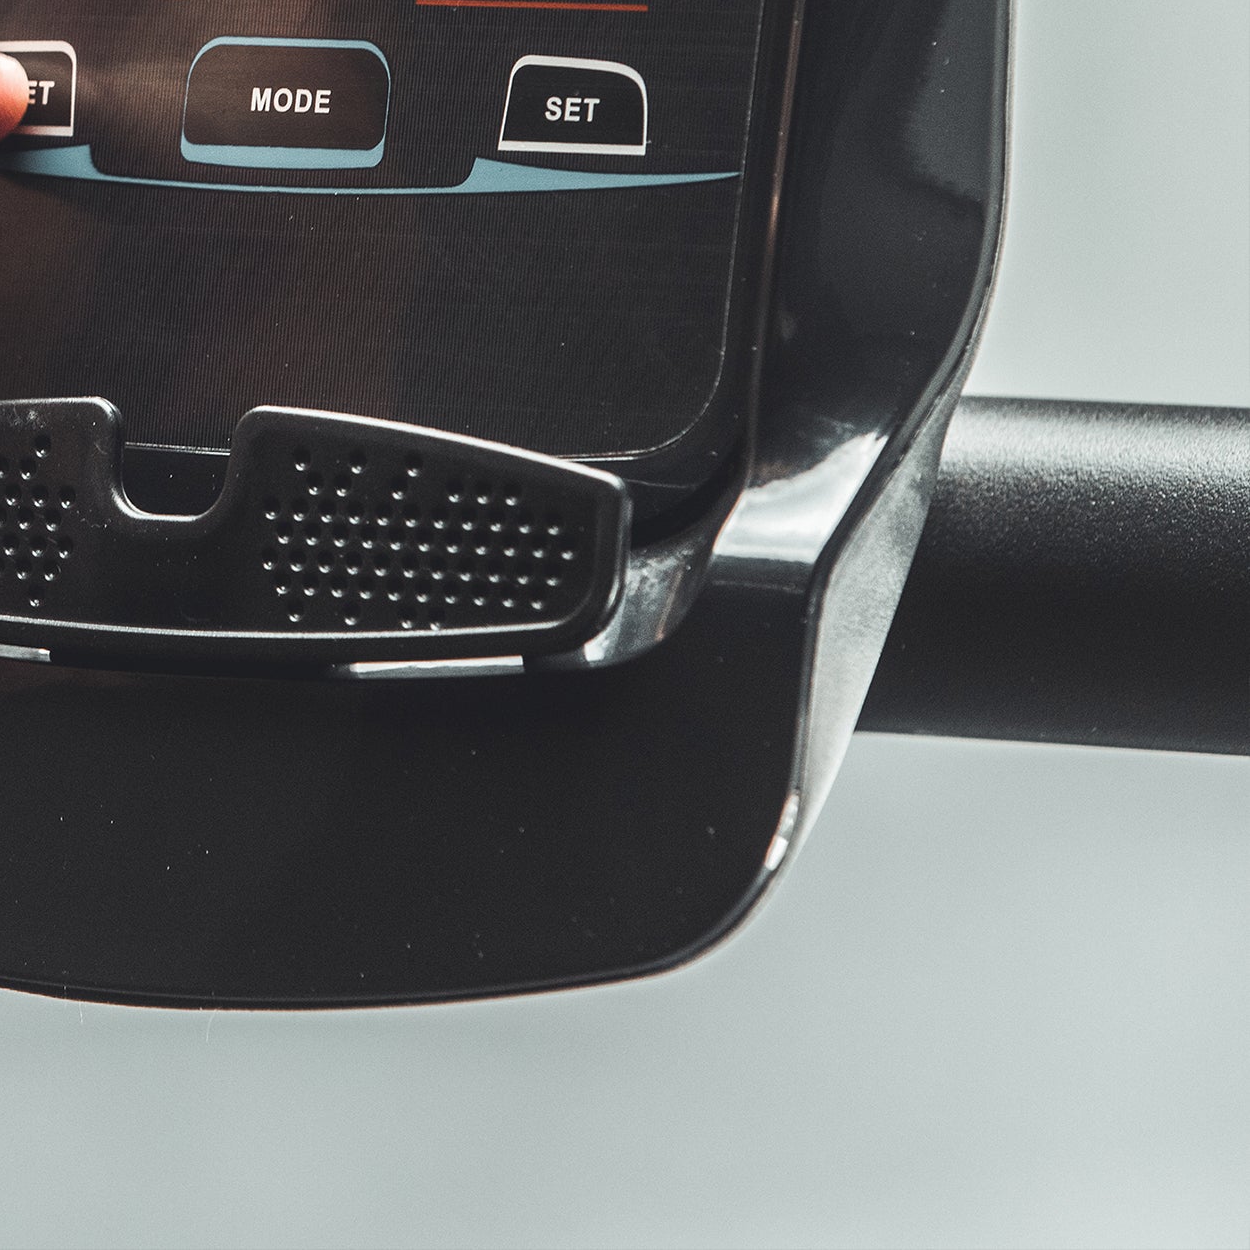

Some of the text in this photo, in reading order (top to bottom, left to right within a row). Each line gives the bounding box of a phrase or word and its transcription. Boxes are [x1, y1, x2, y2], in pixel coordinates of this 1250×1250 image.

[27, 79, 56, 106] ET
[249, 87, 333, 115] MODE
[543, 95, 602, 123] SET
